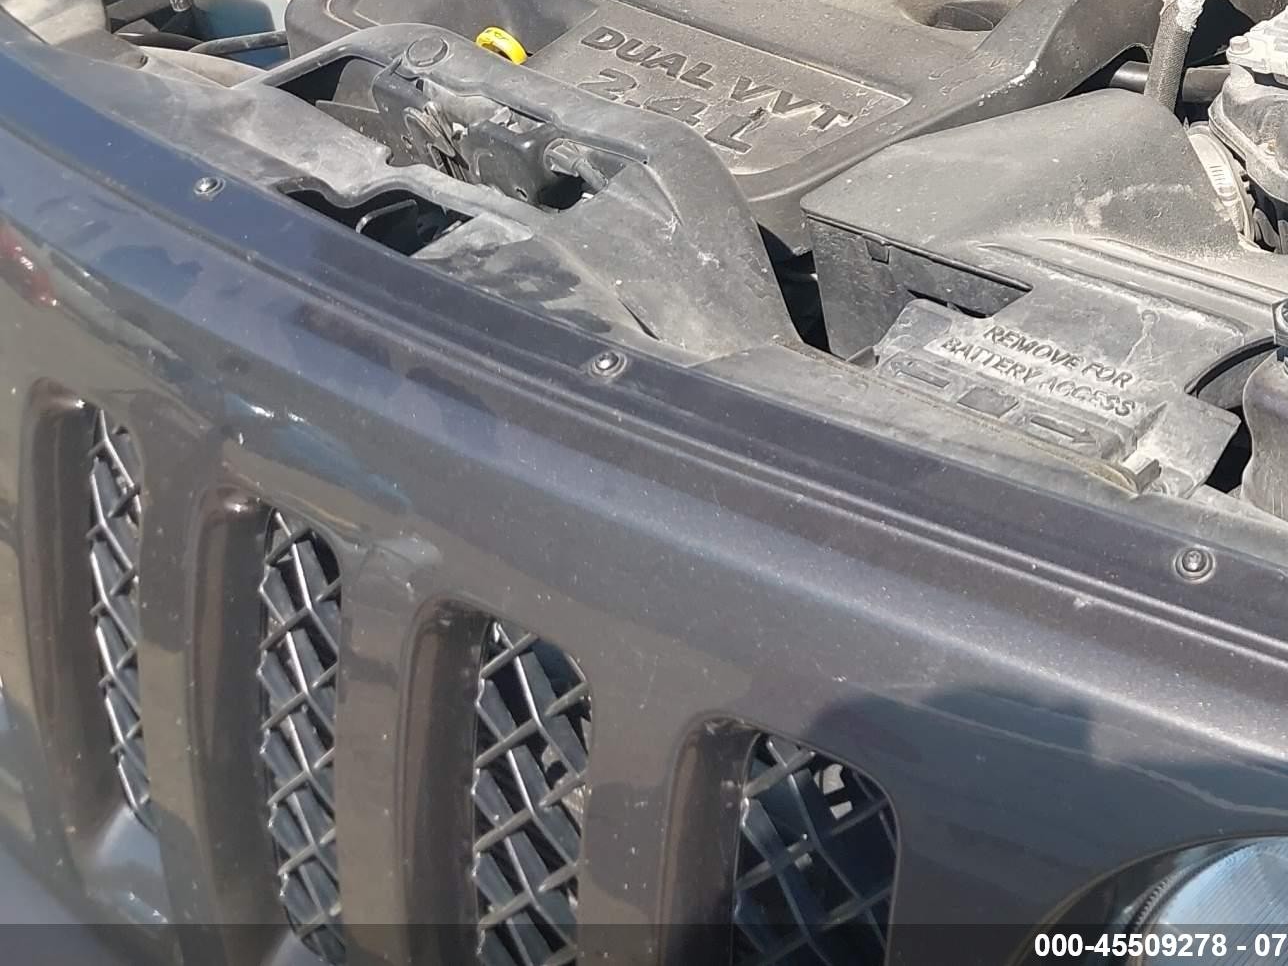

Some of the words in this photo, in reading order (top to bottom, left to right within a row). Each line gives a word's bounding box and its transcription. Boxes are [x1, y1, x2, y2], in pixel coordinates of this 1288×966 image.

[580, 25, 715, 90] DUAL
[728, 75, 853, 131] VVT
[940, 336, 1043, 384] BATTERY
[1039, 376, 1137, 418] ACCESS
[982, 324, 1085, 371] REMOVE
[1081, 362, 1135, 390] FOR
